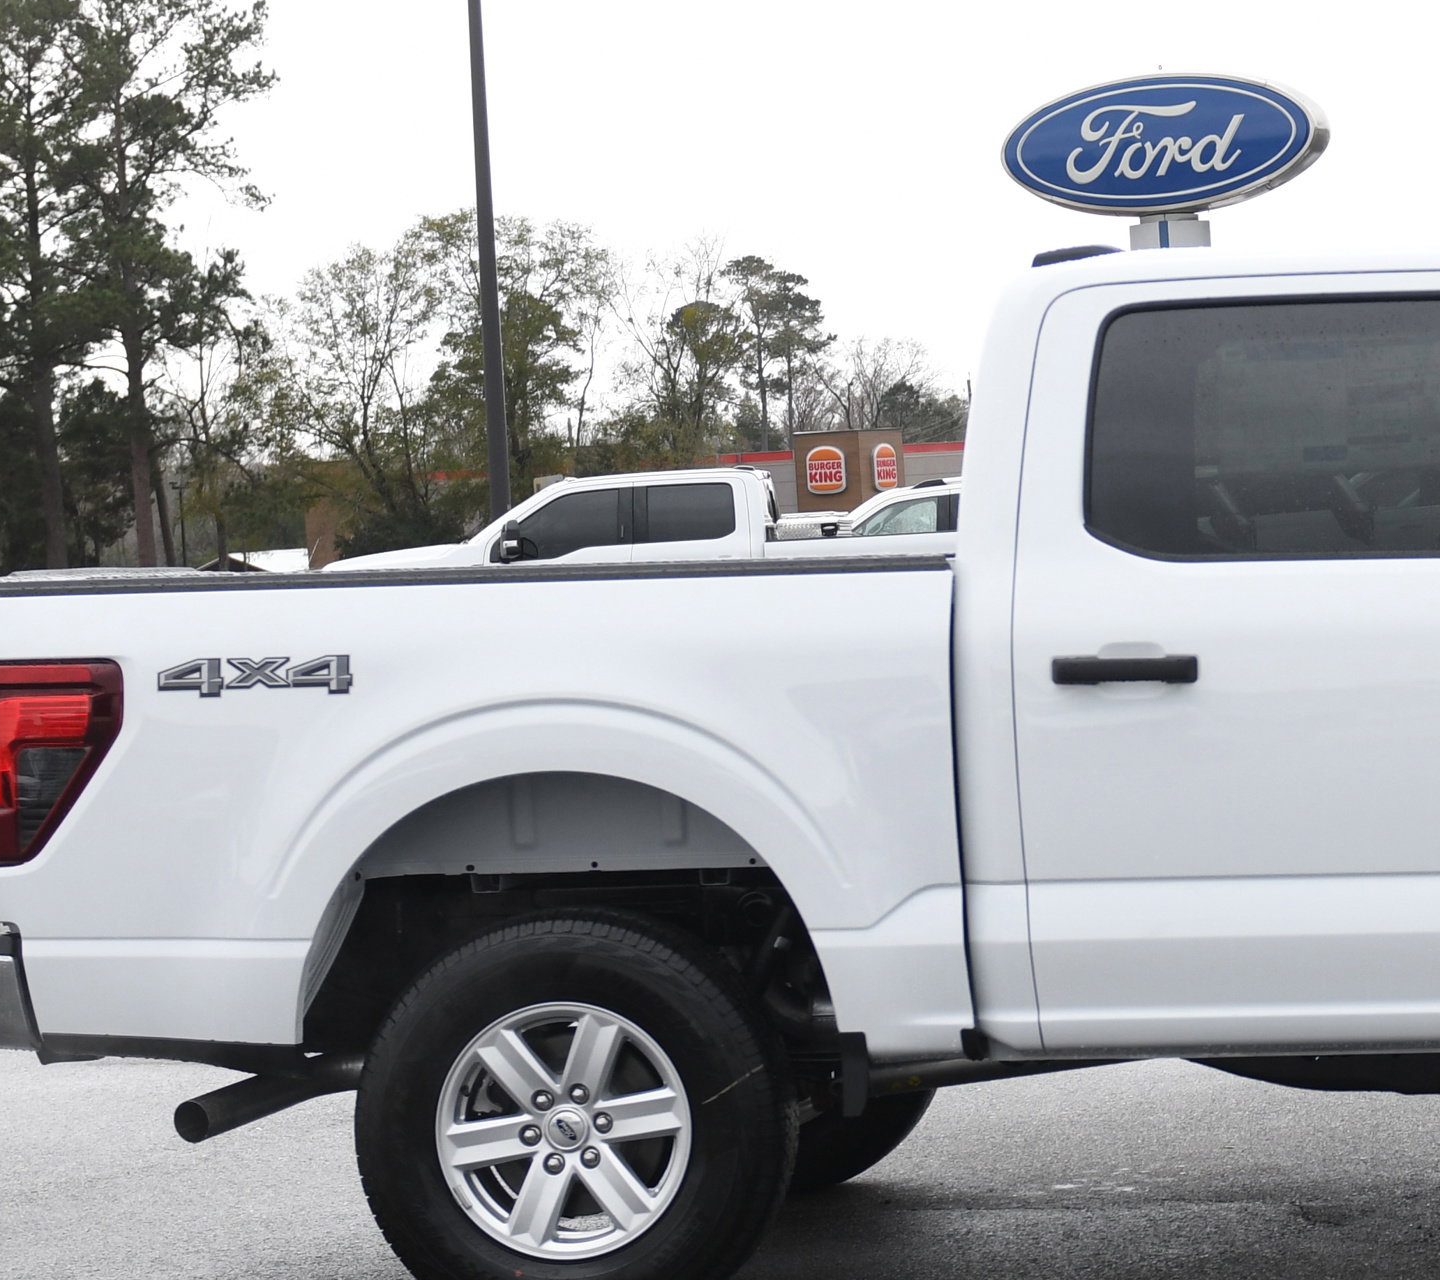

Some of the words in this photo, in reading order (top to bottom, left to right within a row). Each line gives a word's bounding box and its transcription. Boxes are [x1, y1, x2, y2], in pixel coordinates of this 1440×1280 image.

[1066, 100, 1245, 185] Ford
[808, 461, 842, 471] BURGER
[808, 470, 843, 483] KING
[876, 469, 897, 480] KING
